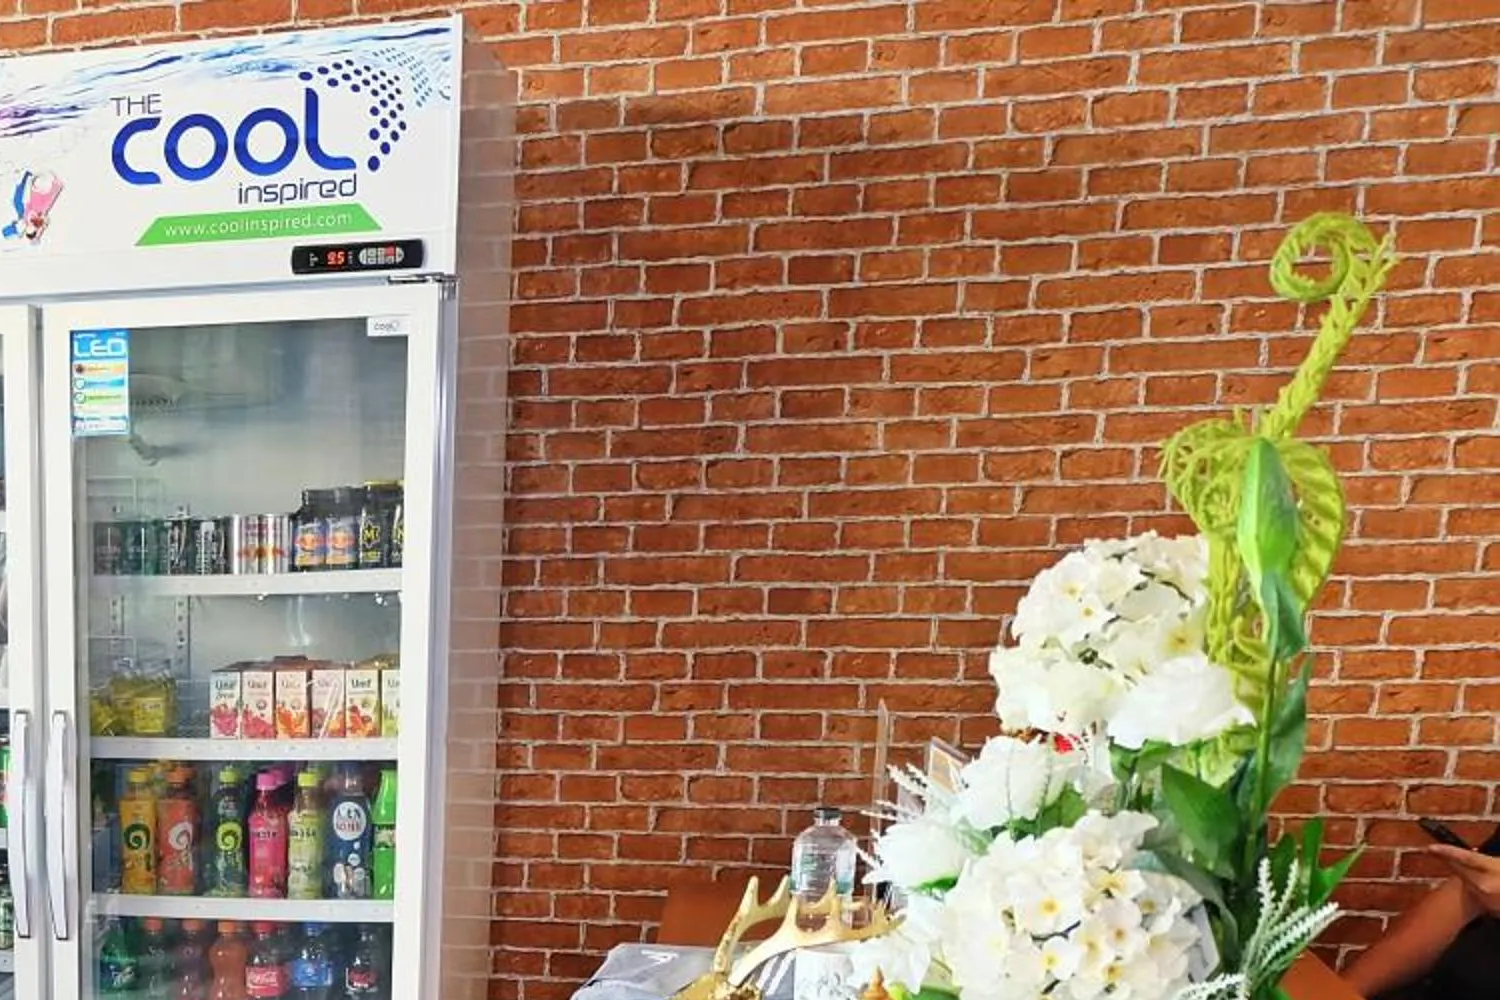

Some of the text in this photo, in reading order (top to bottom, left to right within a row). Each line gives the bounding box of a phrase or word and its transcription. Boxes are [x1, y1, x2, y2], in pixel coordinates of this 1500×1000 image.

[110, 93, 162, 116] THE
[238, 174, 357, 205] inspired
[164, 212, 353, 238] www.coolinspired.com
[73, 337, 127, 357] LED
